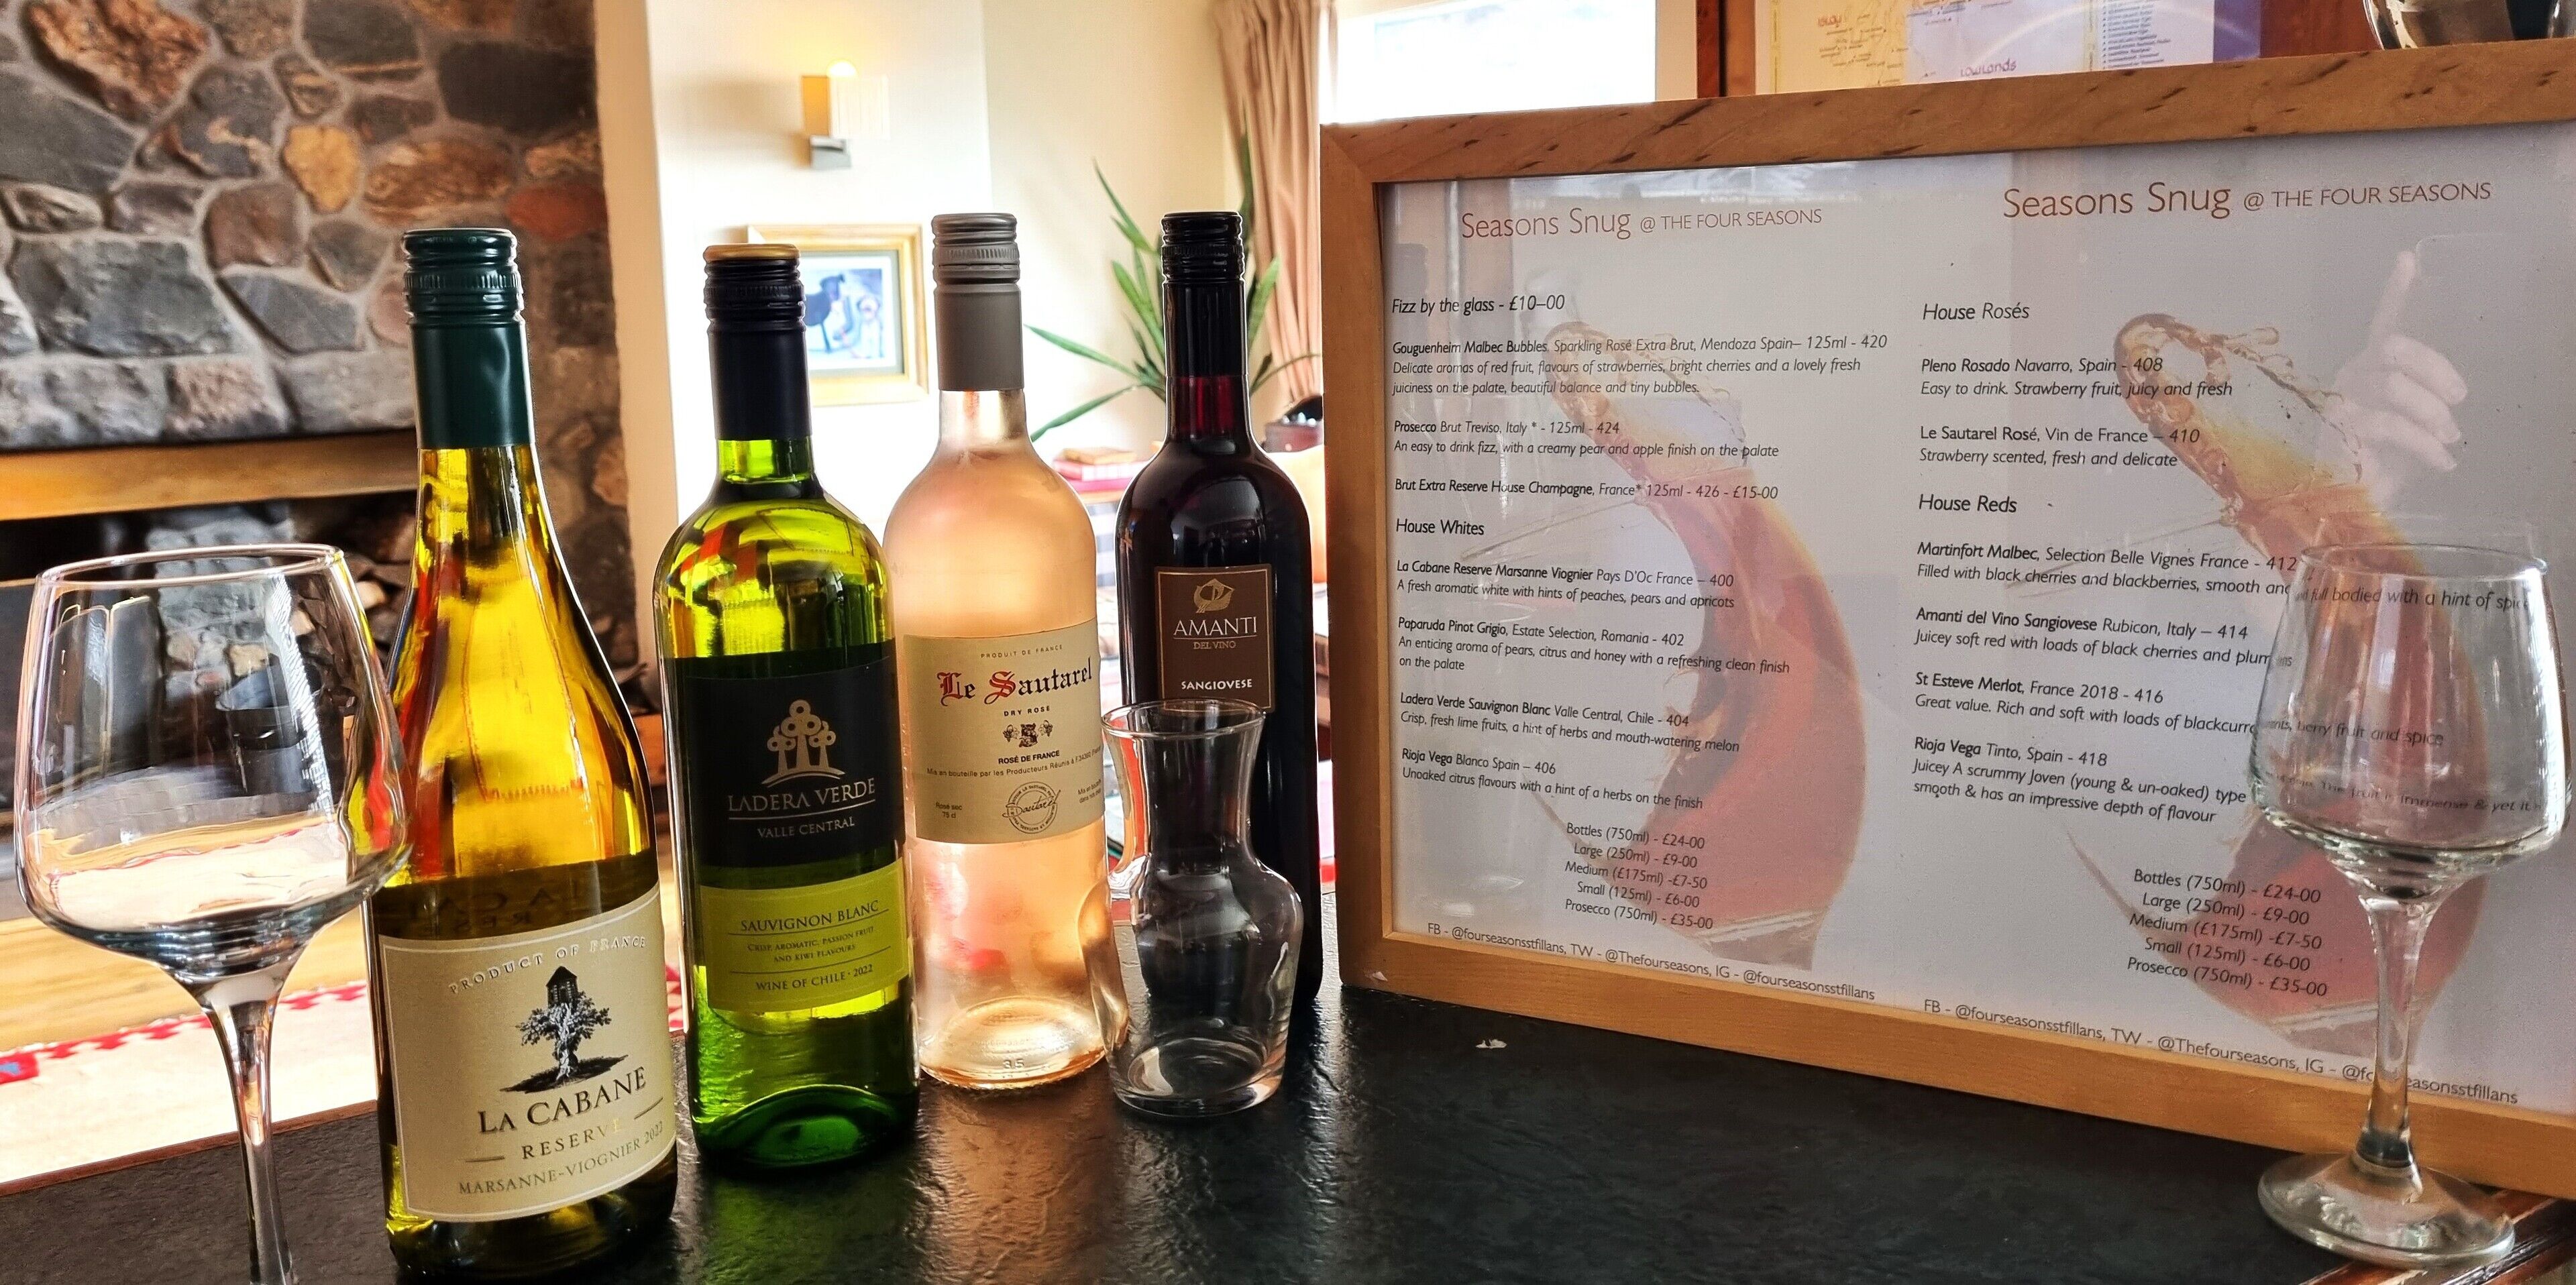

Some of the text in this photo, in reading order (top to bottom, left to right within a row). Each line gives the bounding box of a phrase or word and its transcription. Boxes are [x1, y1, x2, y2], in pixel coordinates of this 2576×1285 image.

[2004, 181, 2490, 220] Seasons Snug @ THE FOUR SEASONS
[1462, 207, 1821, 240] Seasons Snug @ THE FOUR SEASONS
[1393, 298, 1416, 313] Fizz
[1420, 298, 1435, 317] by
[1440, 297, 1459, 313] the
[1464, 297, 1494, 317] glass
[1923, 302, 2029, 320] House Rosés
[1393, 357, 1860, 376] Delicate aromas of red fruit, flavours of strawberries, bright cherries and a lovely fresh
[1393, 379, 1700, 396] juiciness on the palate, beautiful balance and tiny bubbles.
[1921, 379, 2232, 401] Easy to drink. Strawberry fruit, juicy and fresh
[1920, 448, 2178, 467] Strawberry scented, fresh and delicate
[1919, 494, 2017, 512] House Reds
[1396, 518, 1484, 535] House Whites
[1397, 579, 1734, 610] A fresh aromatic white with hints of peaches, pears and apricots
[1173, 616, 1257, 636] AMANTI
[981, 651, 1018, 659] PRODUIT
[1036, 644, 1063, 654] FRANCE
[1193, 640, 1236, 650] DEL VINO
[936, 656, 1093, 706] Le Sautarel
[1181, 678, 1253, 691] SANGIOVESE
[998, 755, 1019, 765] ROSÉ
[1032, 750, 1061, 761] FRANCE
[1006, 766, 1048, 775] Producteurs
[728, 777, 875, 812] LADERA VERDE
[1914, 783, 2216, 822] smooth & has an impressive depth of flavour
[757, 816, 855, 838] VALLE CENTRAL
[1565, 860, 1609, 877] Medium
[1613, 866, 1663, 887] (£175ml)
[741, 899, 879, 932] SAUVIGNON BLANC
[822, 933, 854, 945] PASSION
[855, 926, 874, 938] FRUIT
[2129, 913, 2188, 934] Medium
[2194, 920, 2262, 946] (£175ml)
[449, 936, 646, 995] PRODUCT OF FRANCE
[773, 955, 792, 963] AND
[795, 951, 814, 960] KIWI
[1428, 922, 1441, 935] FB
[1452, 926, 1566, 955] @fourseasonsstfillans,
[1570, 943, 1593, 957] TW
[1605, 948, 1711, 977] @Thefourseasons,
[1716, 964, 1729, 979] IG
[1743, 969, 1874, 1001] @fourseasonsstfillans
[756, 963, 873, 991] WINE OF CHILE 2022
[478, 1066, 647, 1135] LA CABANE
[522, 1118, 621, 1160] RESERVE
[459, 1138, 641, 1194] MARSANNE-VIOGNIER
